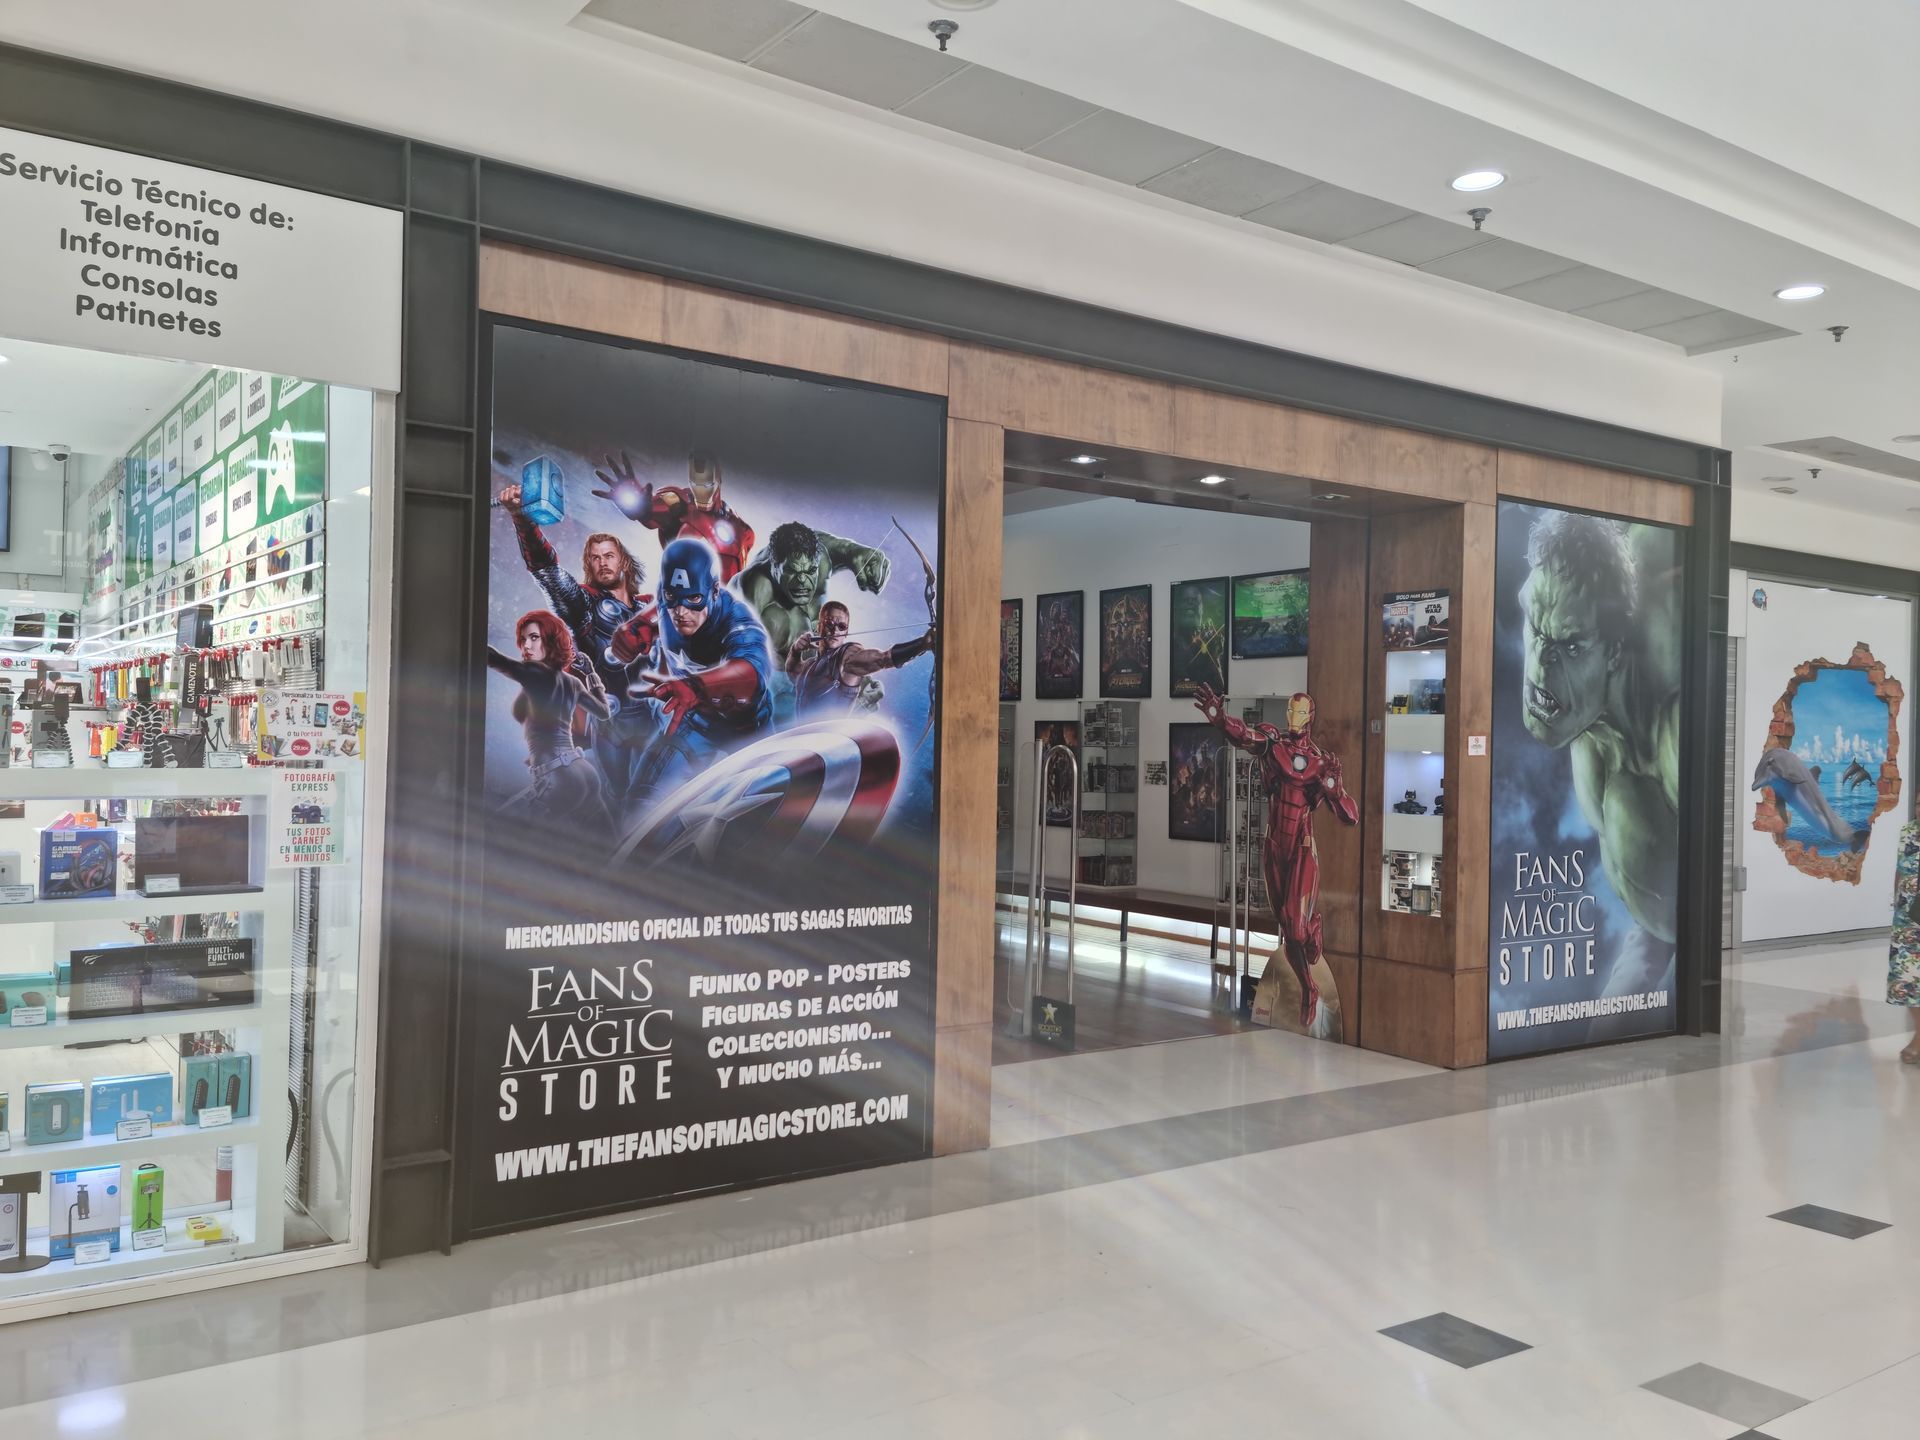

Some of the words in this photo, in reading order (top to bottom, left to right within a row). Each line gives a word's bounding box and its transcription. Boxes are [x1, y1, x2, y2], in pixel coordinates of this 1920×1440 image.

[0, 152, 123, 196] Servicio
[131, 176, 241, 219] Técnico
[250, 203, 294, 231] de:
[81, 200, 219, 246] Telefonía
[60, 228, 238, 280] Informática
[81, 264, 218, 307] Consolas
[76, 294, 221, 337] Patinetes
[186, 661, 197, 704] GAMENOTE
[284, 772, 336, 782] FOTOGRAFÍA
[292, 783, 329, 792] EXPRESS
[280, 845, 291, 854] EN
[294, 845, 322, 854] MENOS
[326, 844, 336, 853] DE
[286, 828, 302, 837] TUS
[305, 827, 331, 836] FOTOS
[292, 836, 325, 845] CARNET
[285, 854, 290, 862] 5
[293, 853, 331, 862] MINUTOS
[1514, 850, 1584, 892] FANS
[1541, 888, 1557, 903] OF
[505, 918, 640, 950] MERCHANDISING
[643, 916, 700, 942] OFICIAL
[704, 914, 723, 937] DE
[725, 912, 770, 935] TODAS
[772, 910, 798, 932] TUS
[800, 907, 845, 931] SAGAS
[847, 904, 913, 928] FAVORITAS
[1500, 895, 1597, 940] MAGIC
[208, 952, 245, 962] FUNCTION
[1500, 940, 1595, 986] STORE
[527, 958, 654, 1013] FANS
[689, 971, 762, 998] FUNKO
[767, 968, 809, 992] POP
[828, 959, 911, 986] POSTERS
[577, 1004, 604, 1022] OF
[701, 1000, 792, 1029] FIGURAS
[797, 998, 823, 1017] DE
[826, 985, 899, 1014] ACCIÓN
[1497, 990, 1668, 1031] WWW.THEFANSOFMAGICSTORE.COM
[502, 1009, 674, 1069] MAGIC
[707, 1022, 892, 1060] COLECCIONISMO...
[716, 1067, 732, 1089] Y
[738, 1058, 813, 1086] MUCHO
[818, 1048, 882, 1076] MÁS...
[499, 1059, 673, 1122] STORE
[495, 1094, 909, 1183] WWW.THEFANSOFMAGICSTORE.COM
